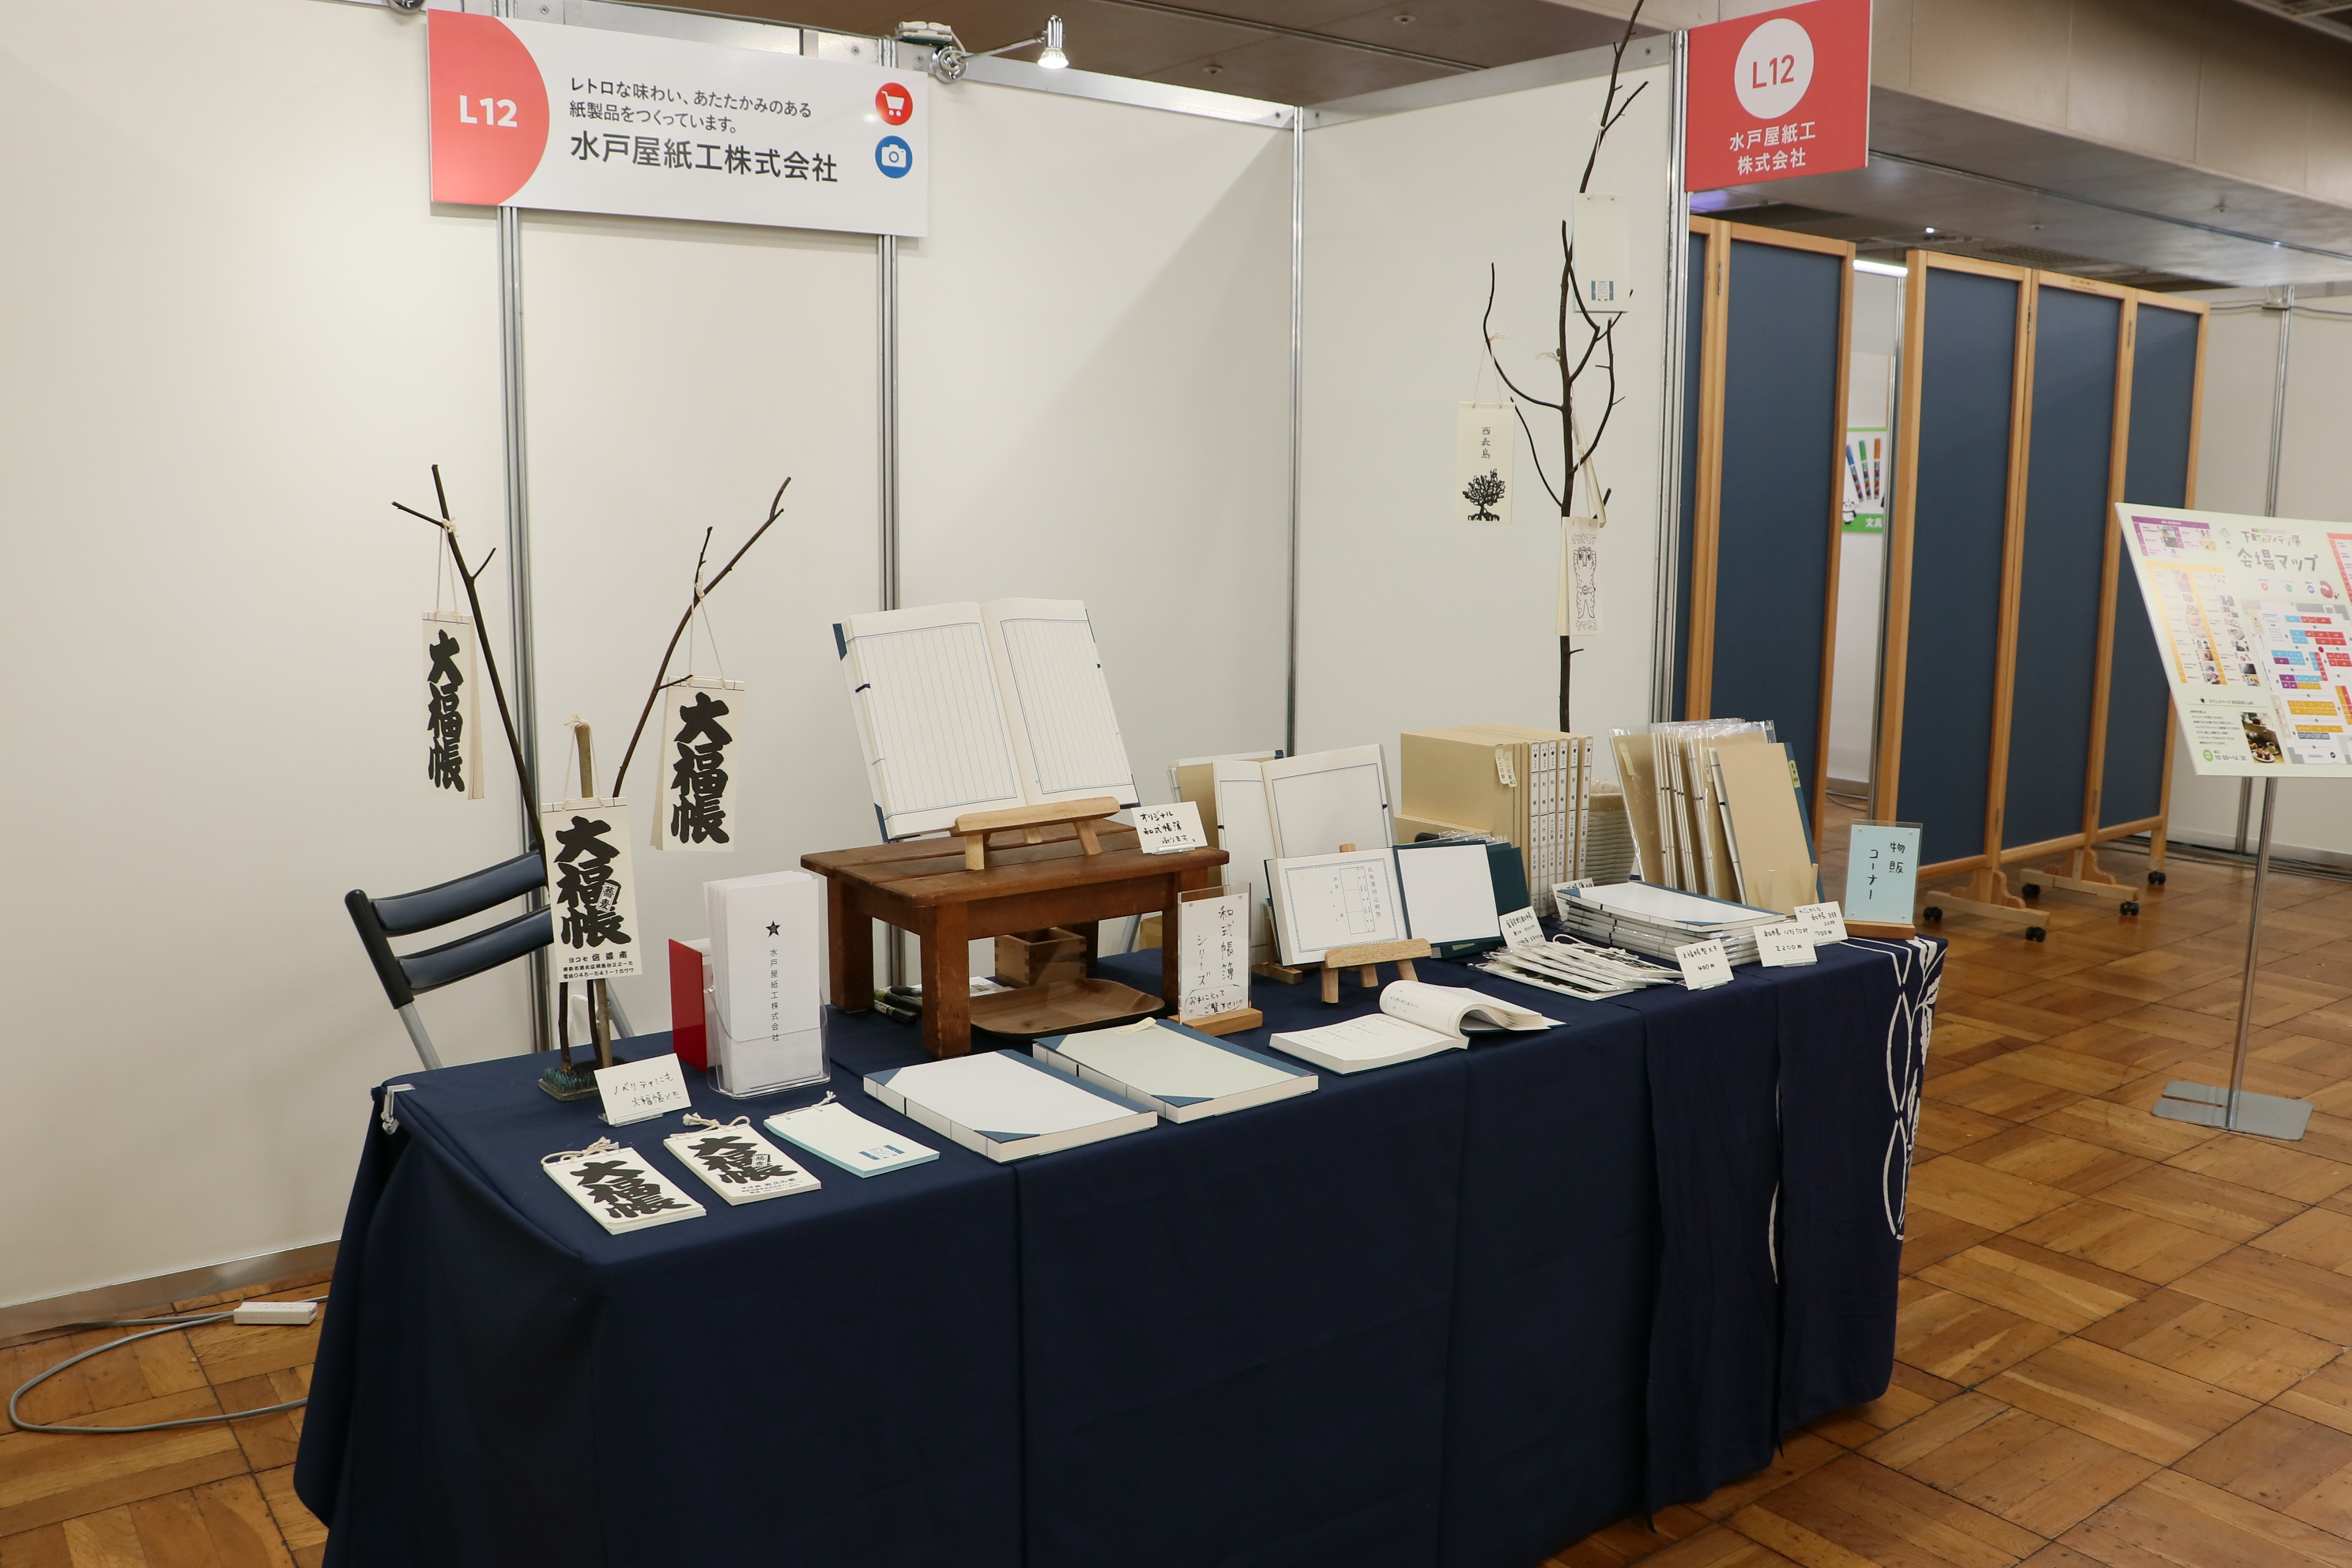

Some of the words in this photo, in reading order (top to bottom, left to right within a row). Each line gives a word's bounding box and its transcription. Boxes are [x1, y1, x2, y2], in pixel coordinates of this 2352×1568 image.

[1752, 55, 1795, 89] L12
[459, 95, 518, 128] L12
[570, 77, 812, 119] レトロな味わい、あたたかみのある
[569, 100, 738, 134] 紙製品をつくっています。
[1729, 121, 1816, 152] 水戸屋紙工
[570, 130, 839, 183] 水戸屋紙工株式会社
[1737, 147, 1806, 175] 株式会社
[1481, 427, 1491, 458] 西表島
[1865, 517, 1883, 528] 文具
[2237, 548, 2319, 571] 会場マップ
[426, 629, 466, 793] 大福帳
[670, 692, 733, 844] 大福帳
[1140, 810, 1174, 822] オリジナル
[1867, 849, 1879, 899] コーナー
[1889, 841, 1905, 874] 物販
[553, 816, 632, 949] 大福帳
[599, 885, 615, 910] 蕎麦
[1218, 905, 1234, 980] 和式帳簿
[1197, 935, 1211, 986] シリーズ
[770, 948, 779, 1042] 水戸屋紙工株式会社
[1189, 989, 1225, 1005] お手にとって
[631, 1091, 681, 1107] 大福帳メモ
[687, 1136, 799, 1184] 大福帳
[570, 1160, 693, 1218] 大福帳
